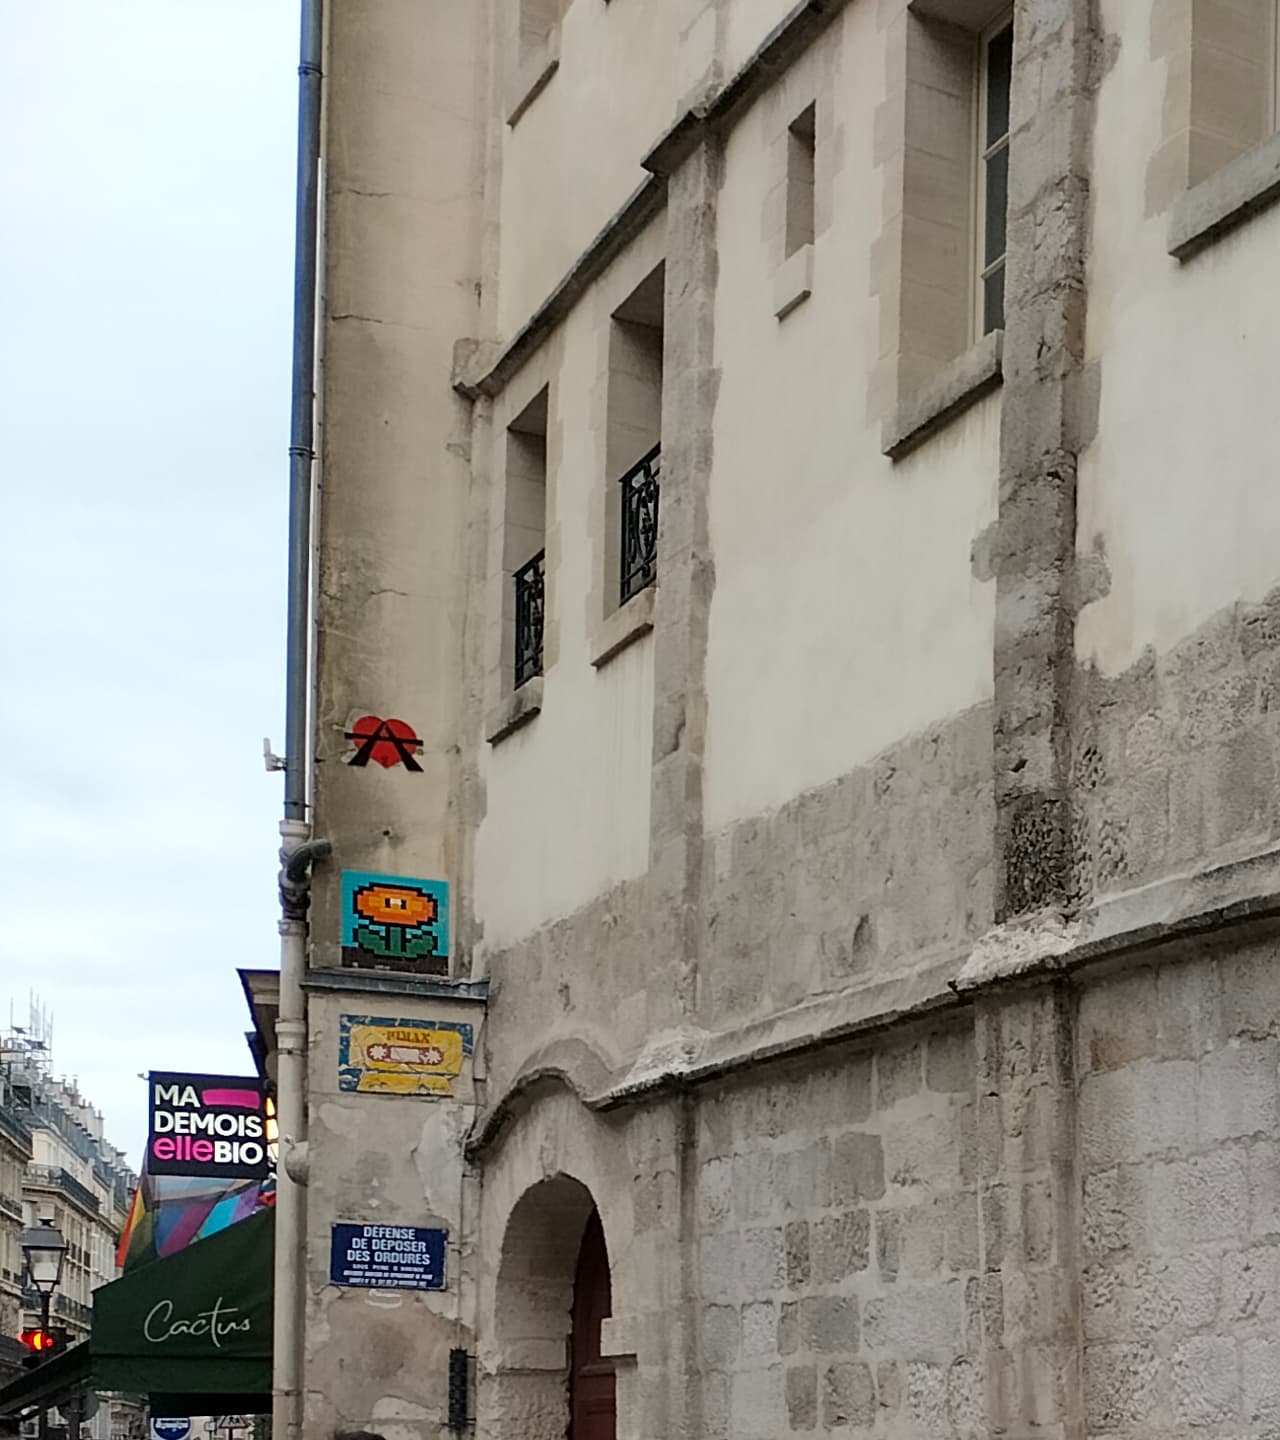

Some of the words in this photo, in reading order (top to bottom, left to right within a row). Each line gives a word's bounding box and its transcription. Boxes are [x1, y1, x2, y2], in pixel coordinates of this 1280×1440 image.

[154, 1083, 201, 1108] MA
[154, 1110, 263, 1138] DEMOIS
[153, 1135, 264, 1165] elleBIO
[352, 1237, 368, 1250] DE
[346, 1249, 371, 1262] DES
[374, 1251, 431, 1265] ORDURES
[143, 1296, 251, 1348] Cactus
